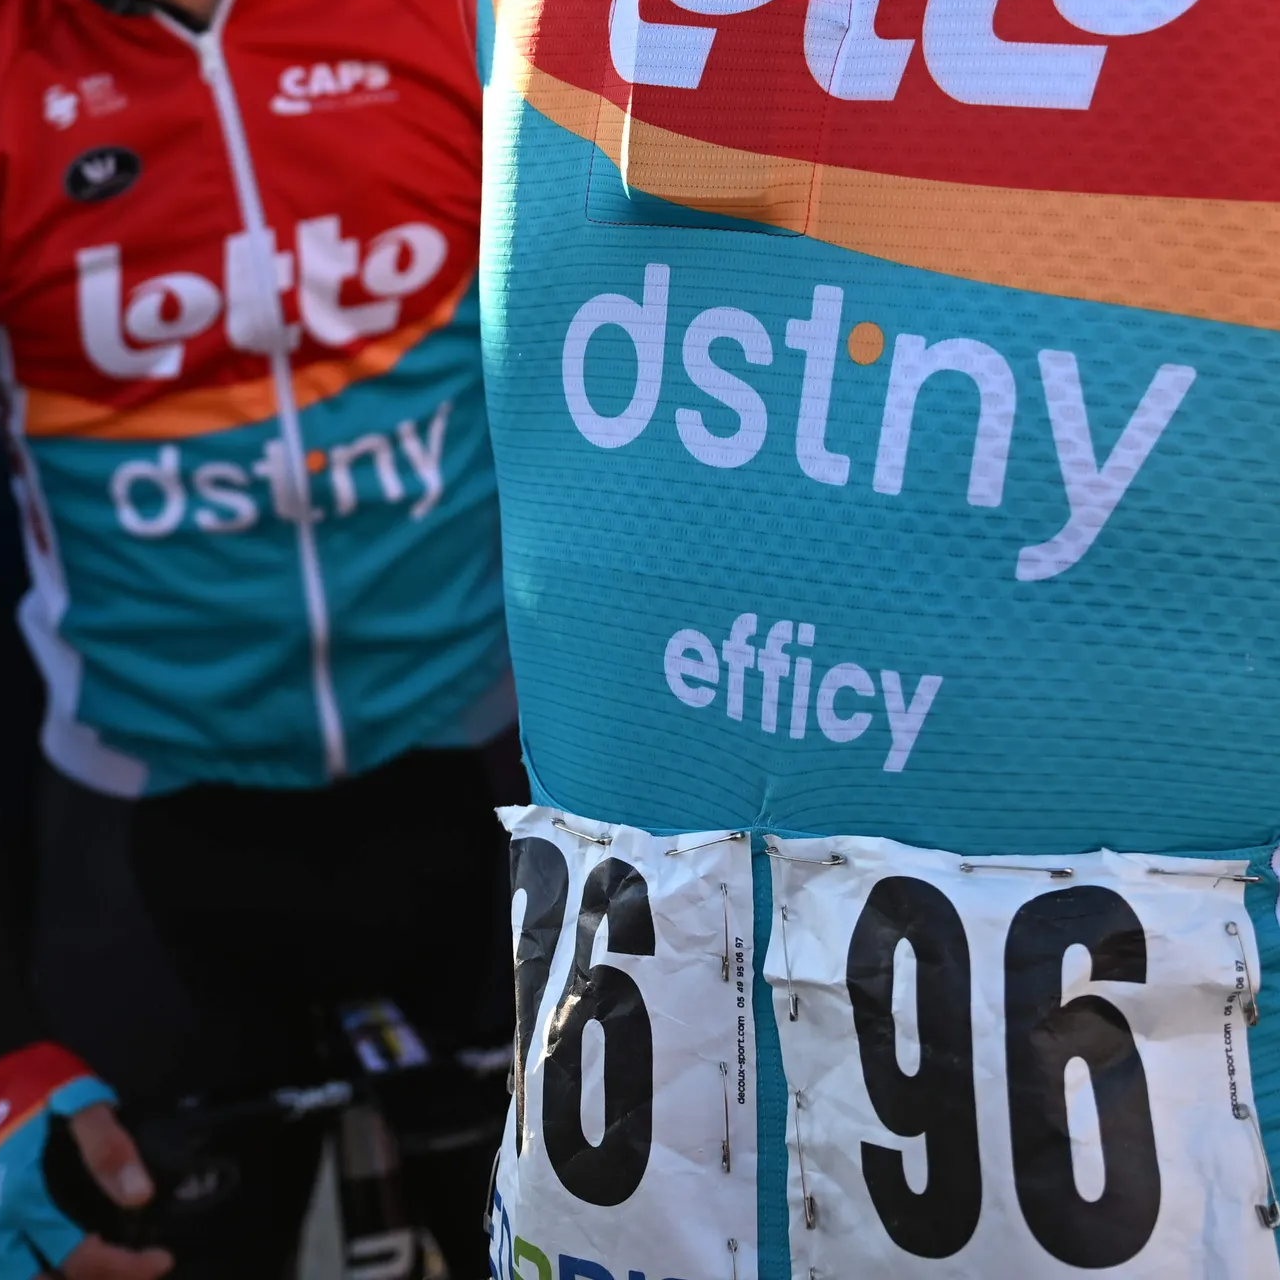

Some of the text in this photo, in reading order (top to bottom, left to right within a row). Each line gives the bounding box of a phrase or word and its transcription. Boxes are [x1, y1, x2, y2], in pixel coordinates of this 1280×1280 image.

[663, 612, 944, 773] efficy
[734, 937, 746, 1105] decoux-sport.com 05 49 95 06 97
[1234, 960, 1245, 972] 97
[846, 875, 1162, 1270] 96
